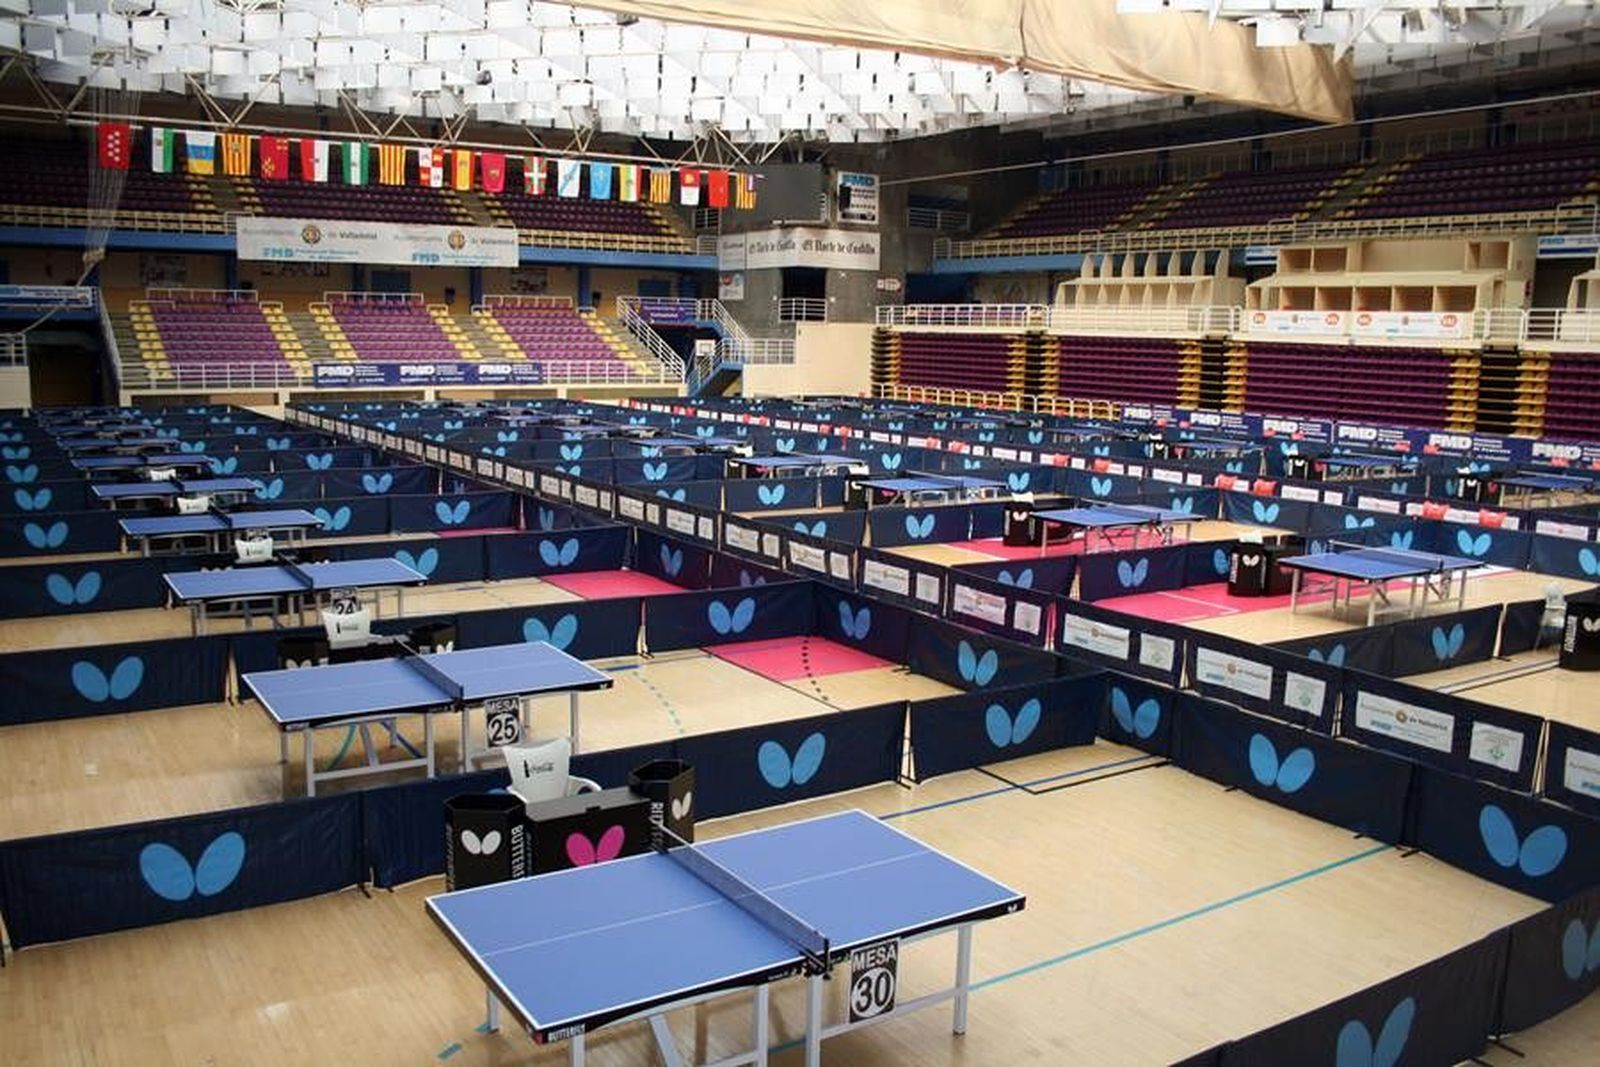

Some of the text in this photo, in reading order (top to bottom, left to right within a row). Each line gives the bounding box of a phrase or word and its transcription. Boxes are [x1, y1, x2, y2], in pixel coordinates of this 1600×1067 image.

[318, 365, 354, 377] FMD
[400, 365, 435, 376] FMD
[1339, 425, 1377, 441] FMD
[1428, 433, 1472, 449] FMD
[1532, 443, 1582, 460] FMD
[491, 716, 515, 741] 25
[853, 944, 897, 972] MESA
[856, 970, 891, 1013] 30
